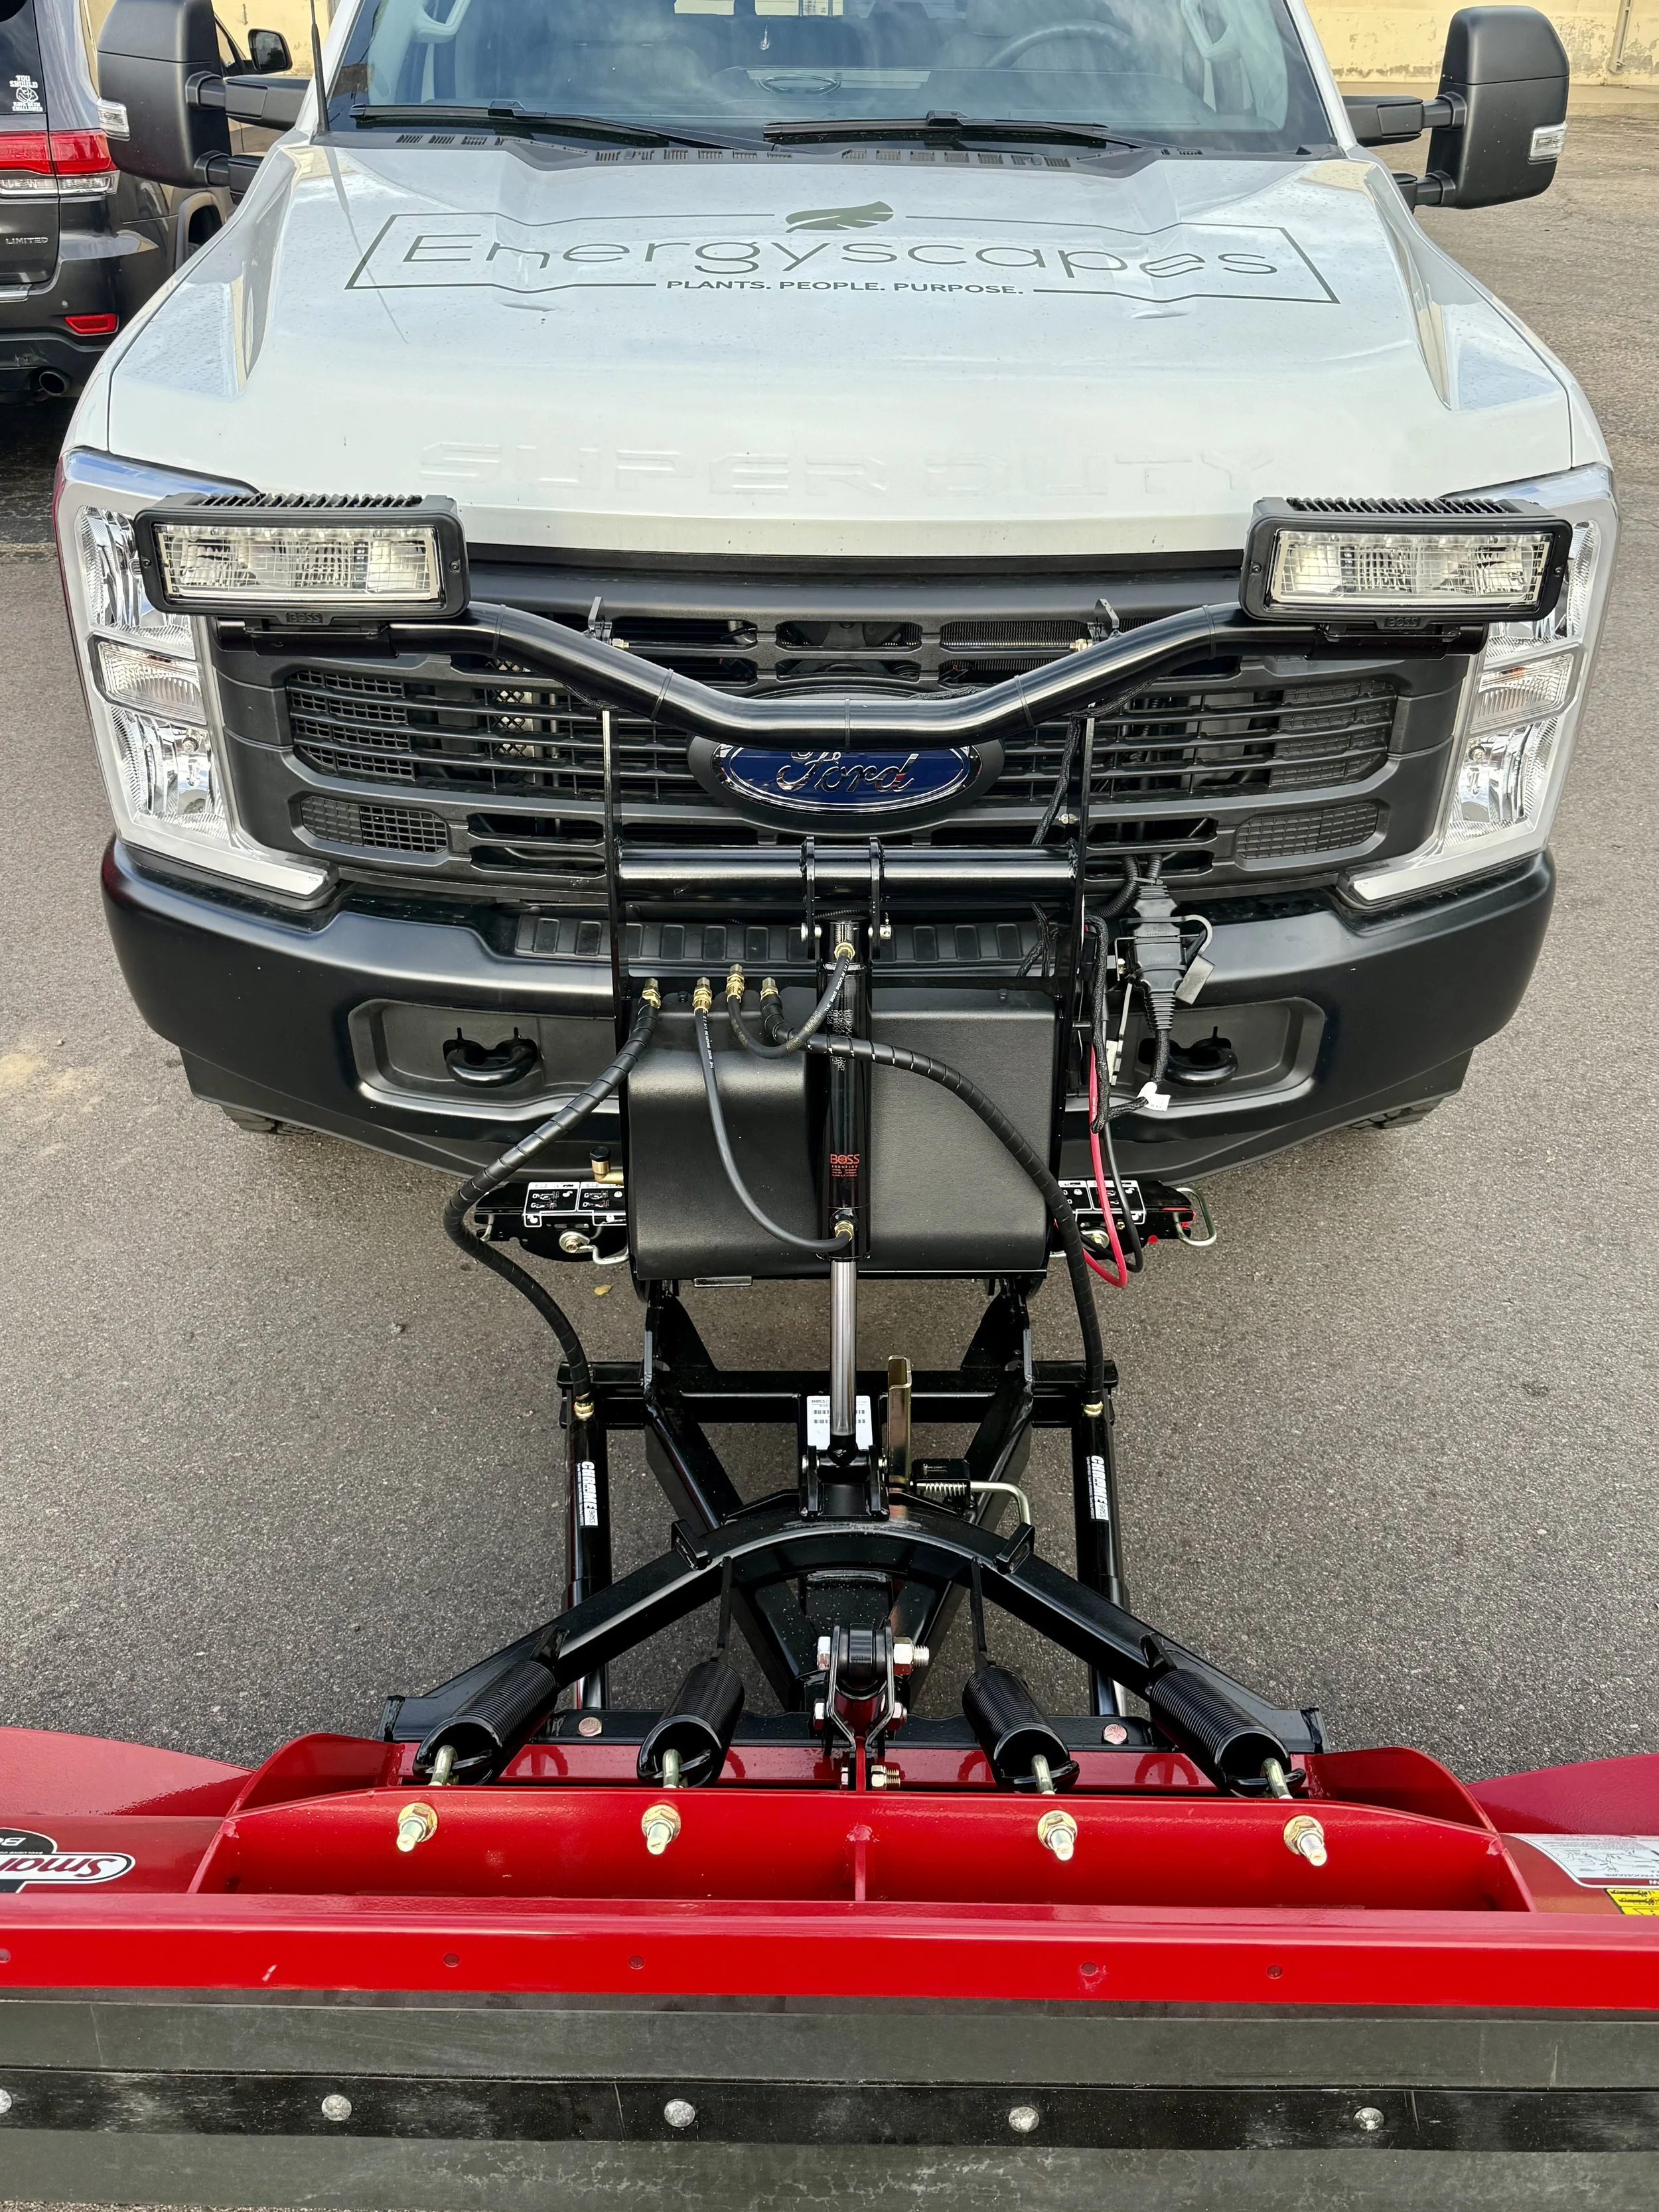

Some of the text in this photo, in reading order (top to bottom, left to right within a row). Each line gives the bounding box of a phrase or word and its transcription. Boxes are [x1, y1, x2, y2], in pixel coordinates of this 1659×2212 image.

[402, 234, 1278, 278] Energyscapes
[667, 280, 1023, 295] PLANTS. PEOPLE. PURPOSE.
[418, 442, 1275, 496] SUPER DUTY
[289, 612, 320, 622] BOSS
[1387, 617, 1418, 626] BOSS
[776, 751, 919, 793] Ford
[830, 1153, 860, 1165] BOSS
